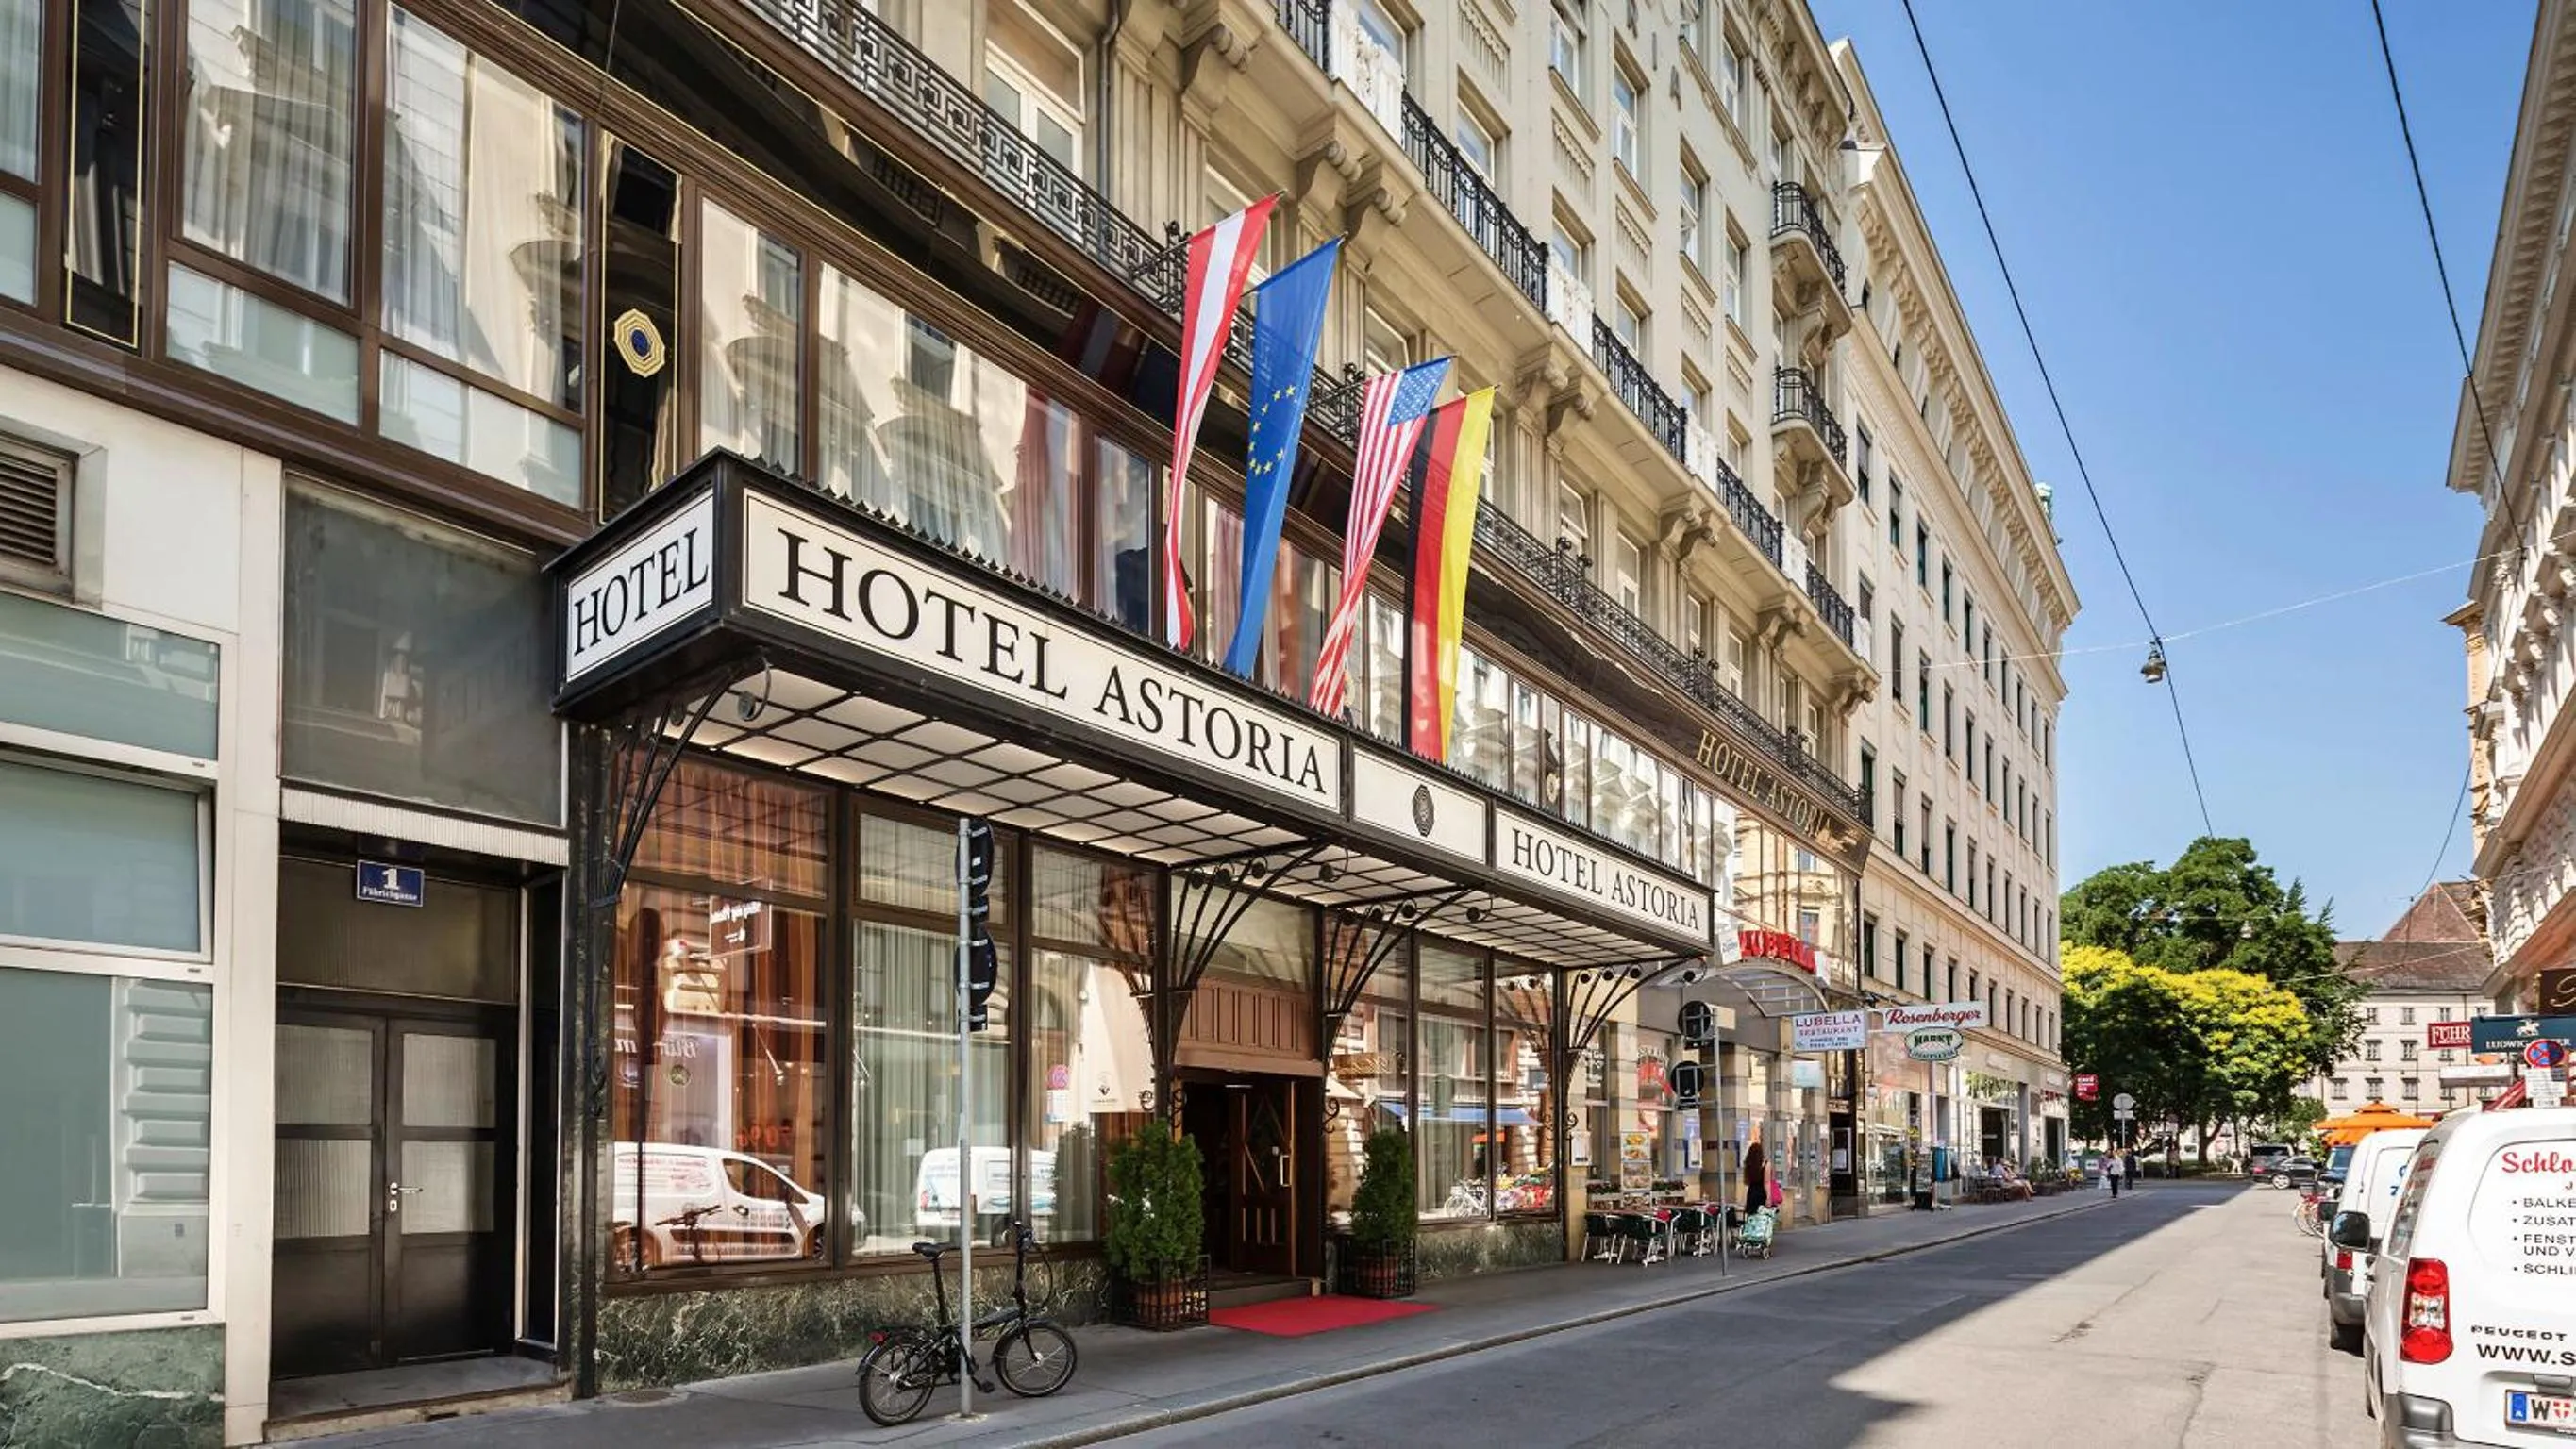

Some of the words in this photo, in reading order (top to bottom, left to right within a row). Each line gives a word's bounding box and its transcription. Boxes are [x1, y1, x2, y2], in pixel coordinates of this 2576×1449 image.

[573, 527, 710, 655] HOTEL
[777, 527, 1069, 701] HOTEL
[1095, 664, 1327, 794] ASTORIA
[1697, 728, 1761, 799] HOTEL
[381, 867, 401, 891] 1
[1512, 827, 1603, 895] HOTEL
[1611, 870, 1699, 932] ASTORIA
[1796, 1013, 1862, 1028] LUBELLA
[1886, 1008, 1982, 1027] Rosenberger
[1914, 1034, 1953, 1048] MARKT
[2523, 1197, 2576, 1208] BALKE
[2523, 1215, 2576, 1227] ZUSAT
[2523, 1233, 2576, 1245] FENST
[2523, 1245, 2560, 1257] UND
[2523, 1263, 2576, 1275] SCHLI
[2470, 1324, 2568, 1341] PEUGEOT
[2476, 1342, 2576, 1367] WWW.S
